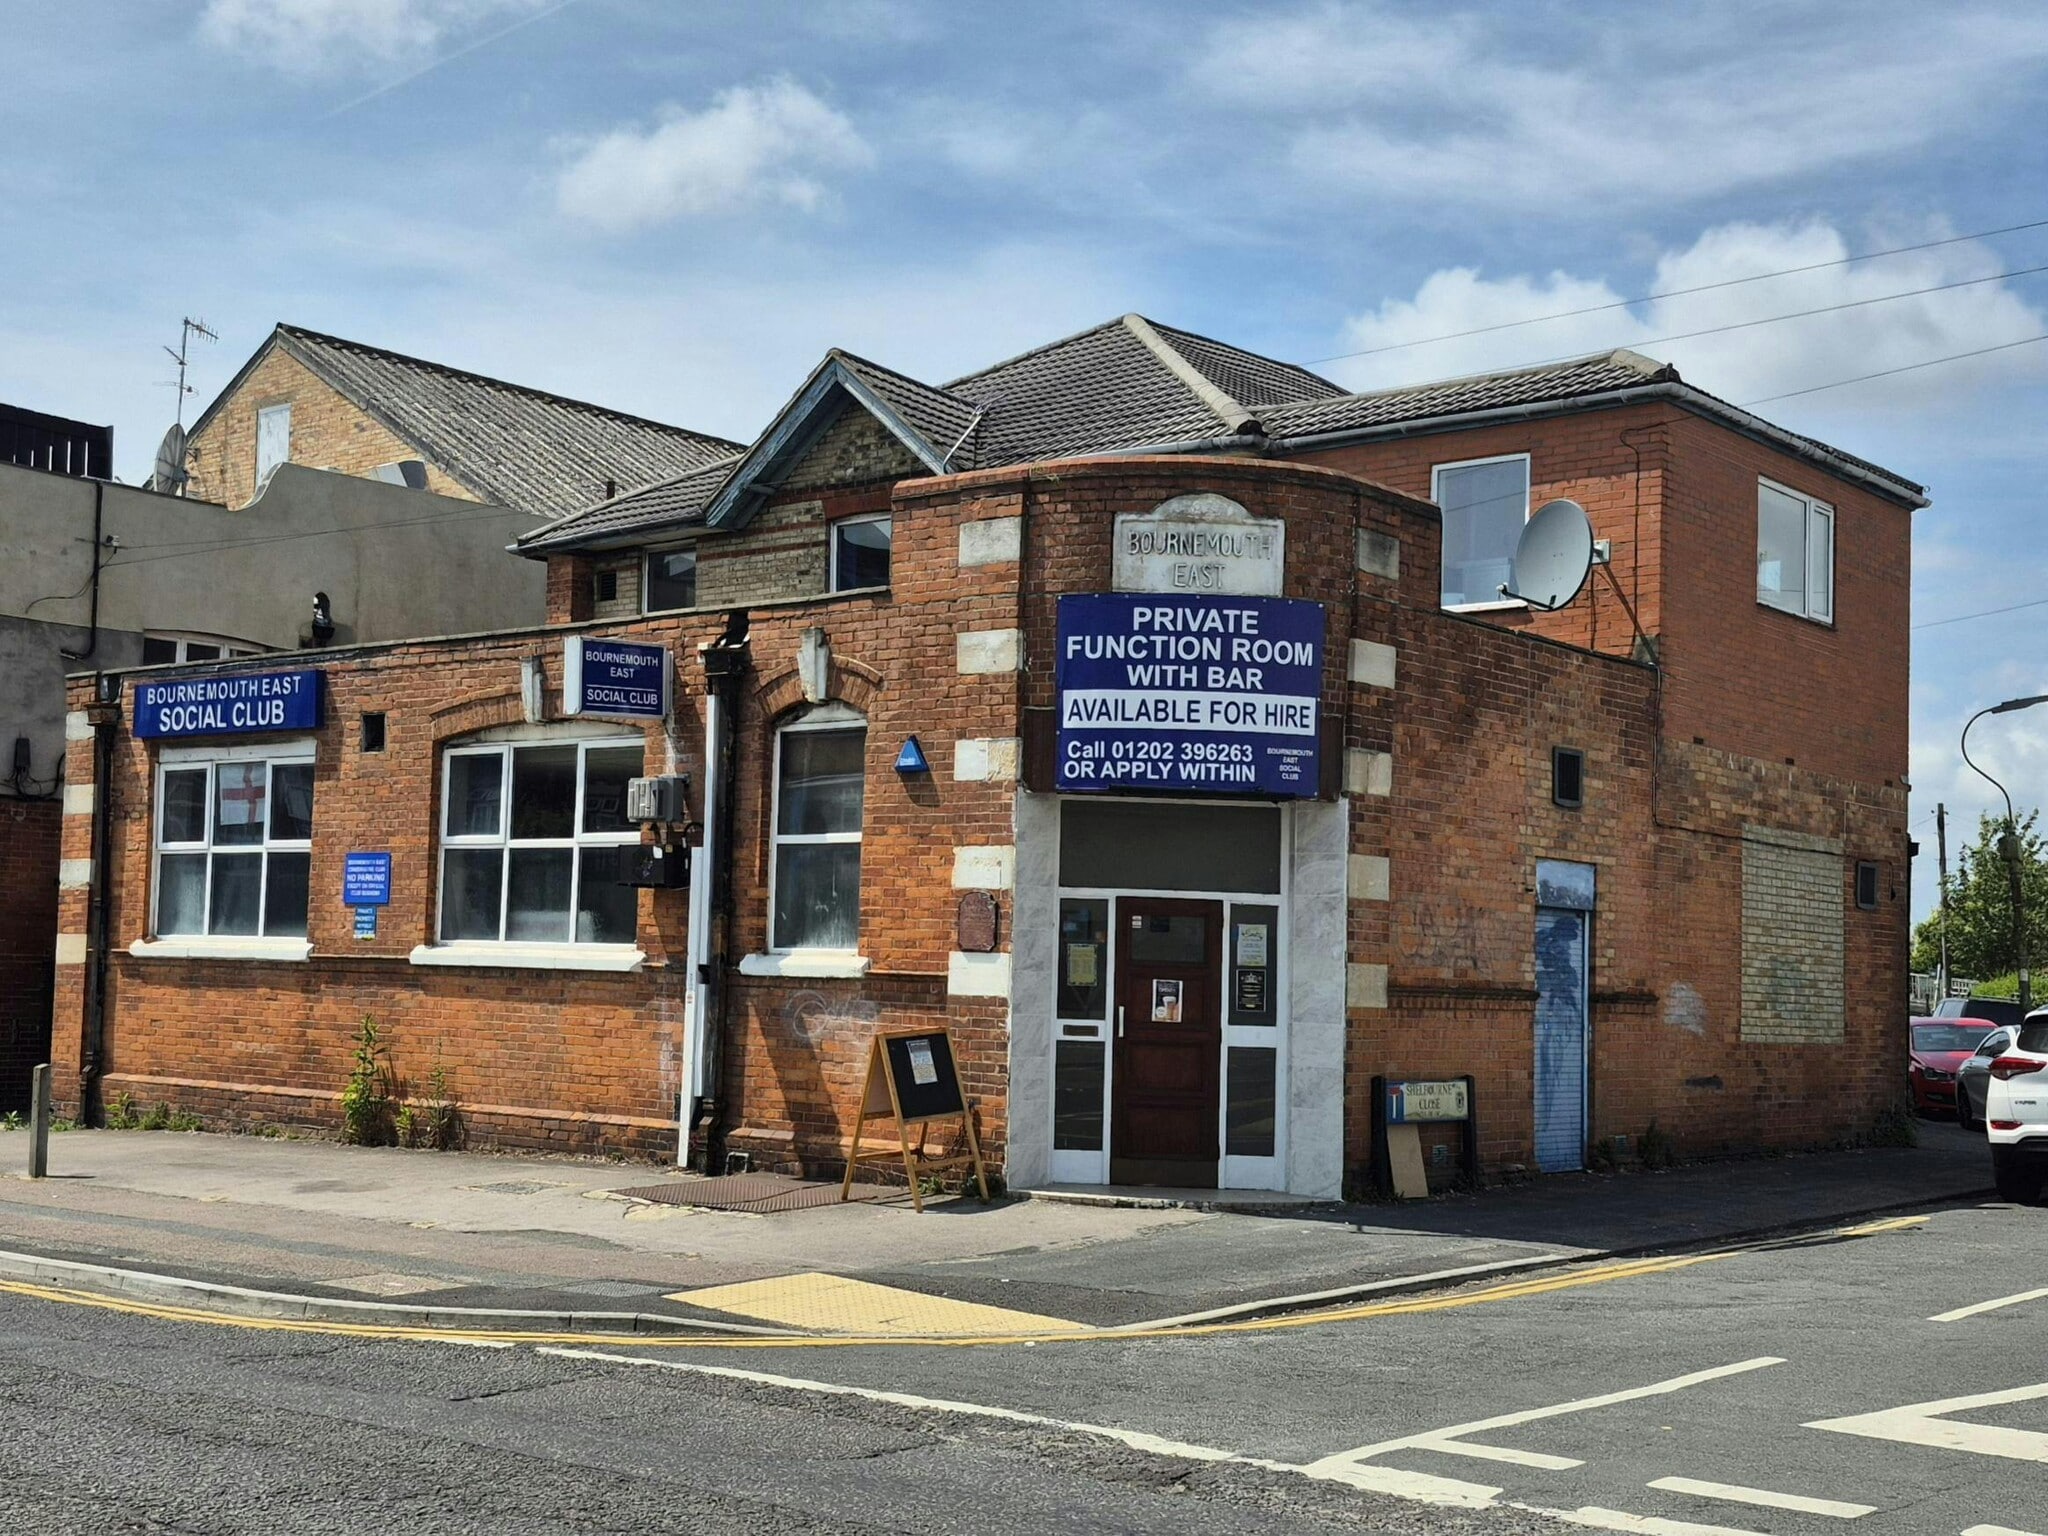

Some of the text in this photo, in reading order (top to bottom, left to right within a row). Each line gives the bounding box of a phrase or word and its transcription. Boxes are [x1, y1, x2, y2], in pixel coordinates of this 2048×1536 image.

[1128, 530, 1274, 560] BOURNEMOUTH
[1174, 563, 1226, 588] EAST
[1133, 606, 1260, 635] PRIVATE
[585, 651, 659, 666] BOURNEMOUTH
[1066, 635, 1313, 667] FUNCTION ROOM
[610, 666, 635, 678] EAST
[1126, 664, 1264, 690] WITH BAR
[147, 675, 302, 705] BOURNEMOUTH EAST
[587, 689, 658, 705] SOCIAL CLUB
[158, 700, 285, 732] SOCIAL CLUB
[1067, 698, 1311, 729] AVAILABLE FOR HIRE
[1067, 740, 1253, 763] Call 01202 396263
[1266, 747, 1314, 757] BOURNEMOUTH
[1282, 756, 1299, 764] EAST
[1063, 760, 1256, 783] OR APPLY WITHIN
[1279, 764, 1302, 773] SOCIAL
[1281, 772, 1299, 780] CLUB
[347, 873, 385, 882] NO PARKING
